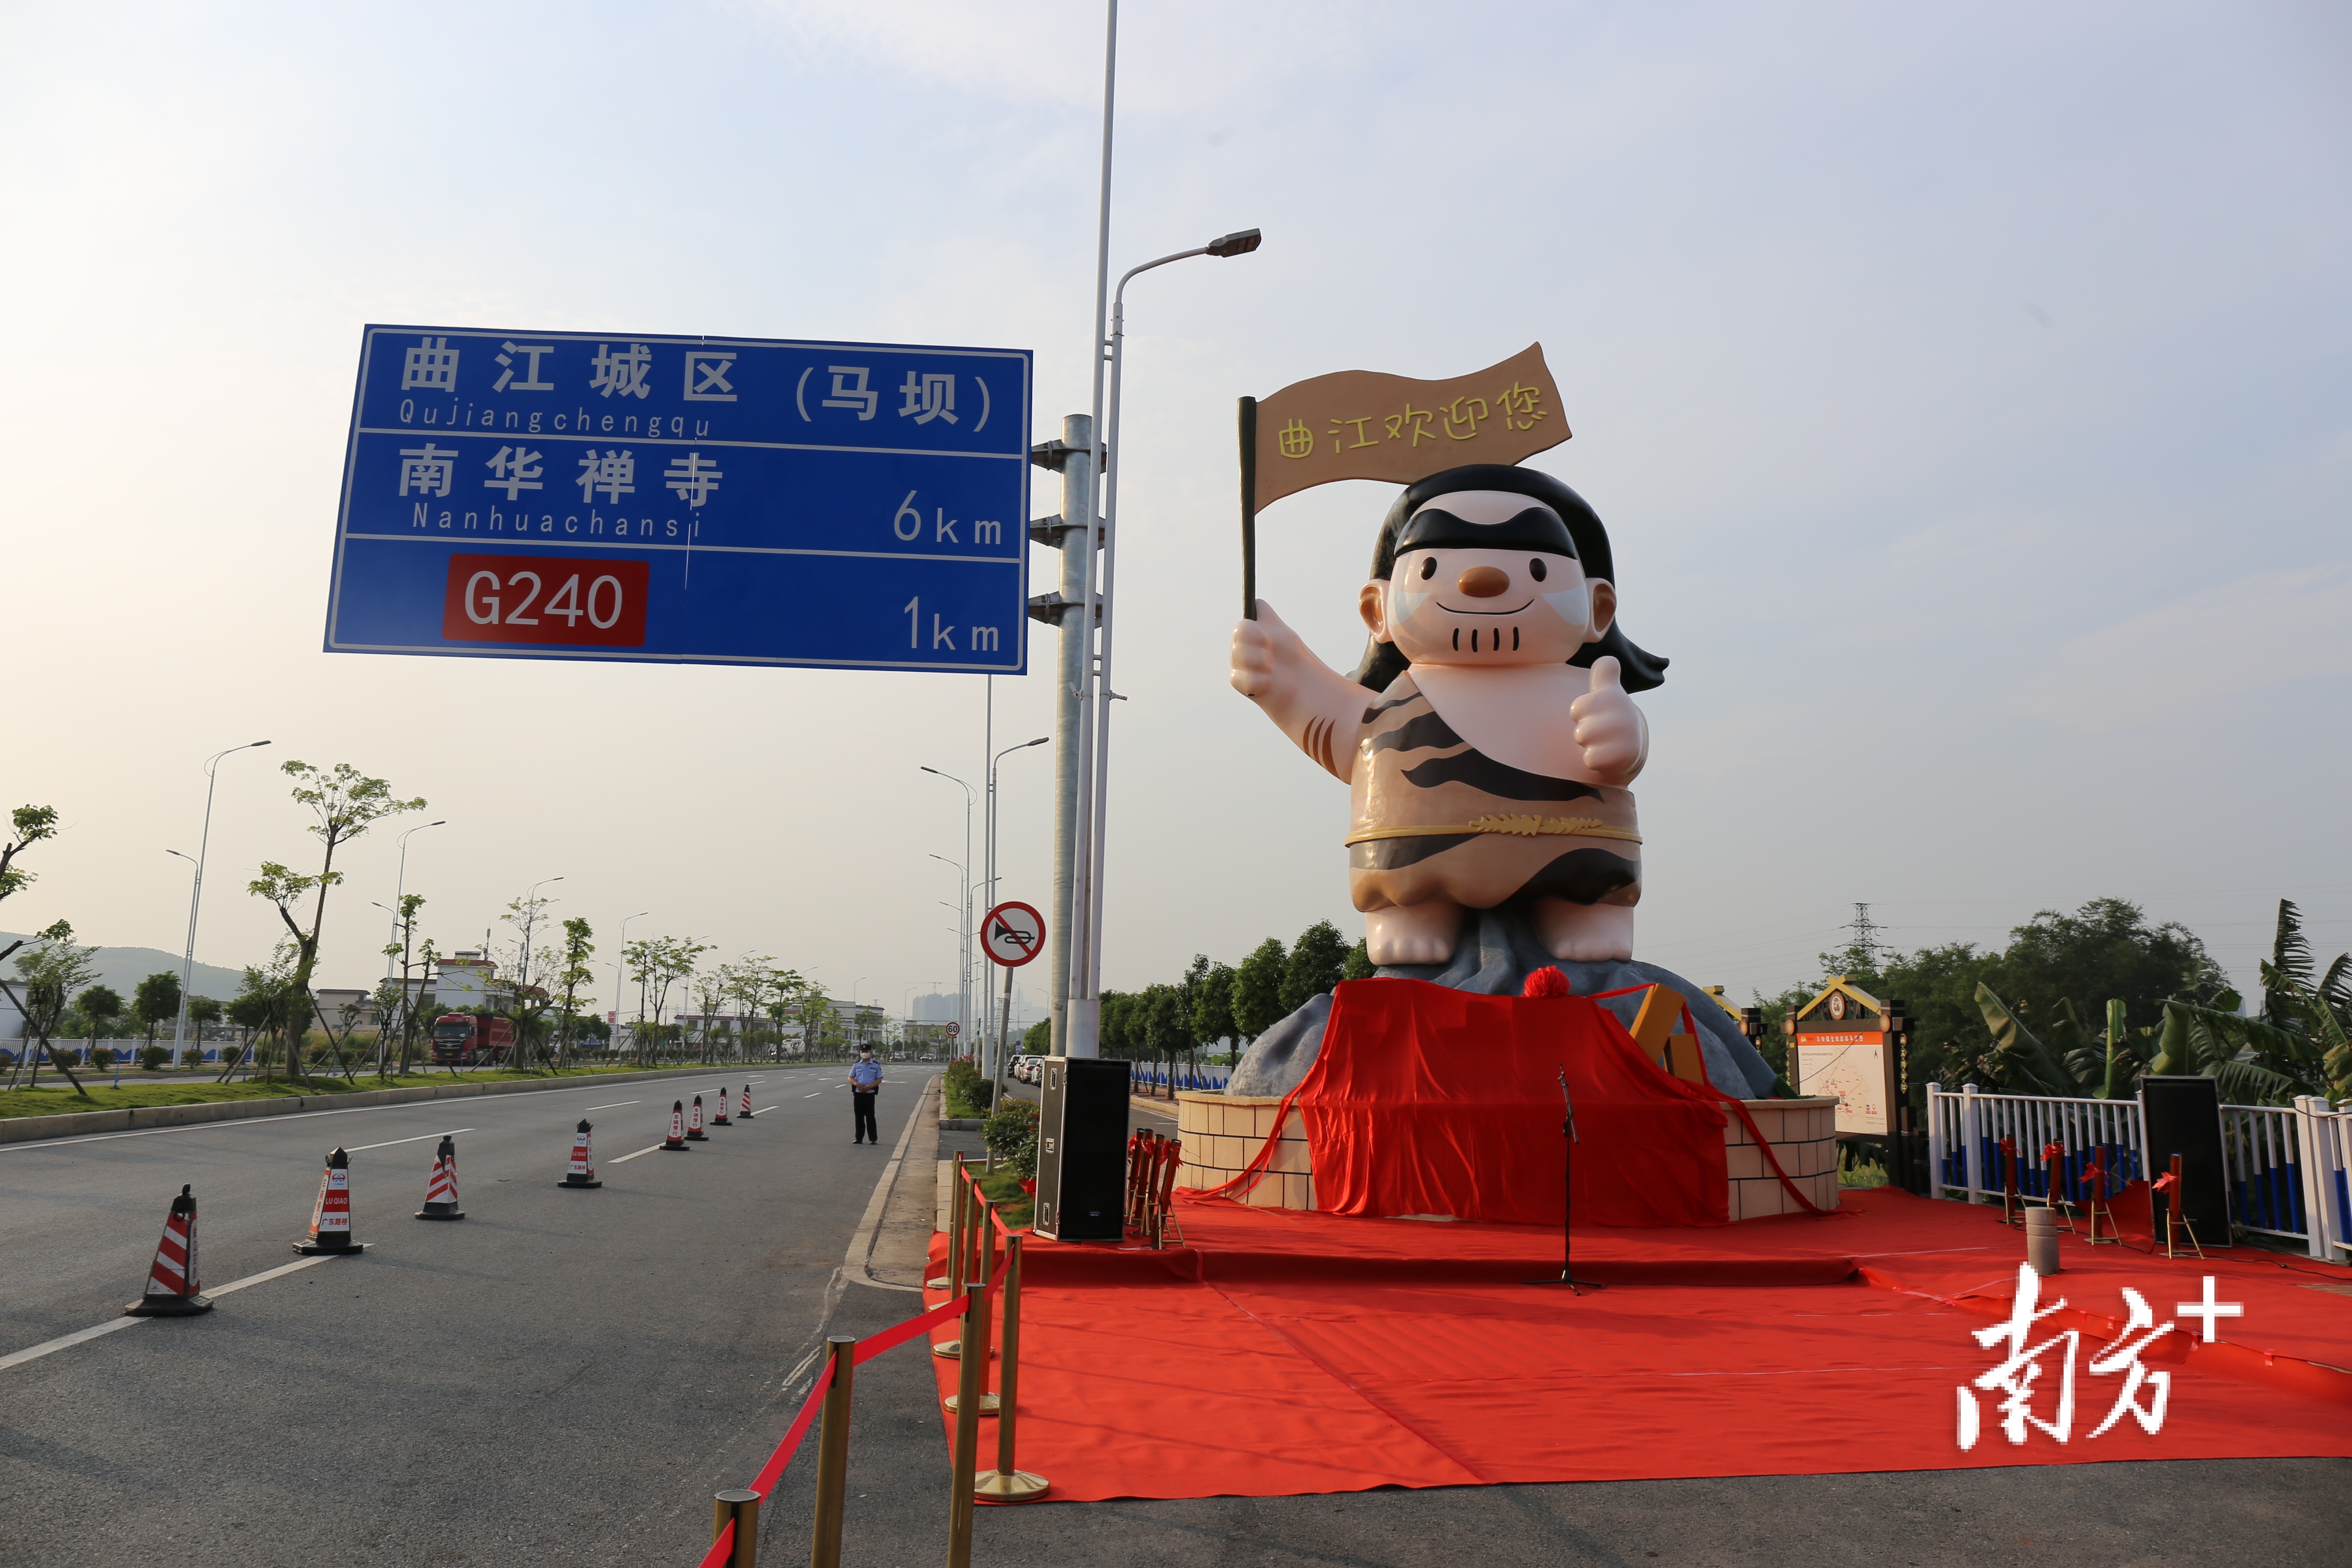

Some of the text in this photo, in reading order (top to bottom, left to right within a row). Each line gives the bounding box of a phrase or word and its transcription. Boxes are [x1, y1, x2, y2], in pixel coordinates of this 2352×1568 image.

[401, 399, 708, 437] Qujiangchengqu
[1279, 382, 1547, 459] 曲江欢迎您
[399, 444, 722, 510] 南华禅寺
[413, 503, 699, 536] Nanhuachansi
[464, 570, 623, 629] G240
